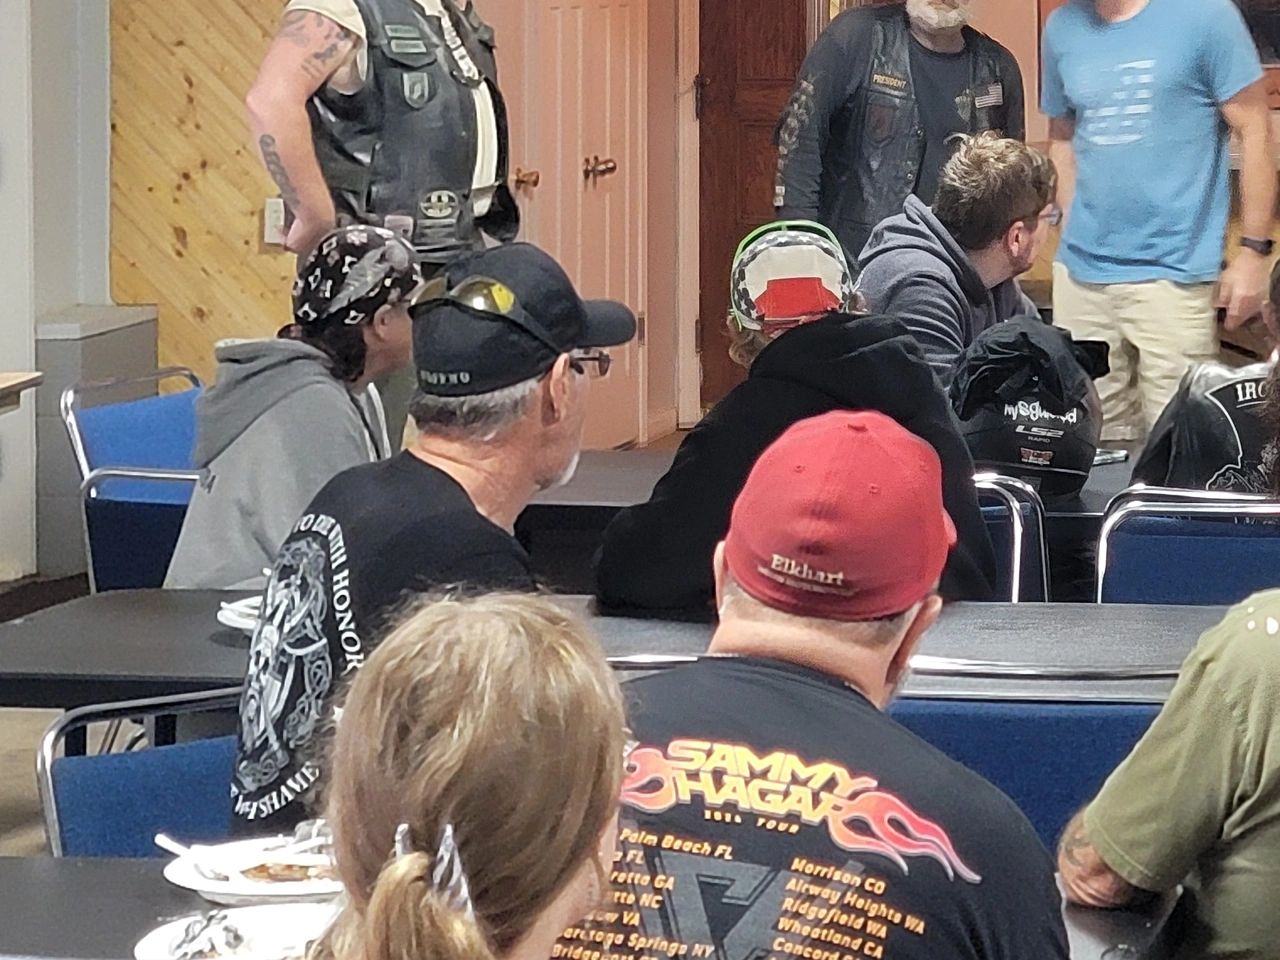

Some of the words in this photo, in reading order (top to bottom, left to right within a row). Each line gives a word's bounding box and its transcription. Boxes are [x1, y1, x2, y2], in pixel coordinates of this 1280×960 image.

[872, 74, 906, 89] PRESIDENT
[1015, 425, 1064, 438] LS2
[770, 553, 844, 585] Elkhart
[333, 568, 365, 677] HONOR
[667, 739, 878, 797] SAMMY
[259, 762, 320, 819] SHAME
[672, 770, 850, 825] HAGAR
[756, 817, 800, 834] TOUR
[620, 828, 658, 846] Palm
[661, 835, 712, 856] Beach
[713, 845, 735, 860] FL
[626, 850, 645, 865] FL
[654, 874, 675, 891] GA
[791, 858, 862, 887] Morrison
[864, 877, 886, 895] CO
[639, 892, 664, 908] NC
[785, 878, 841, 904] Airway
[843, 891, 902, 924] Heights
[904, 914, 925, 935] WA
[622, 911, 640, 927] VA
[781, 896, 865, 930] Ridgefield
[866, 920, 888, 939] WA
[627, 933, 688, 957] Springs
[691, 943, 715, 958] NY
[772, 937, 840, 960] Concord
[777, 917, 863, 950] Wheatland
[863, 941, 885, 959] CA
